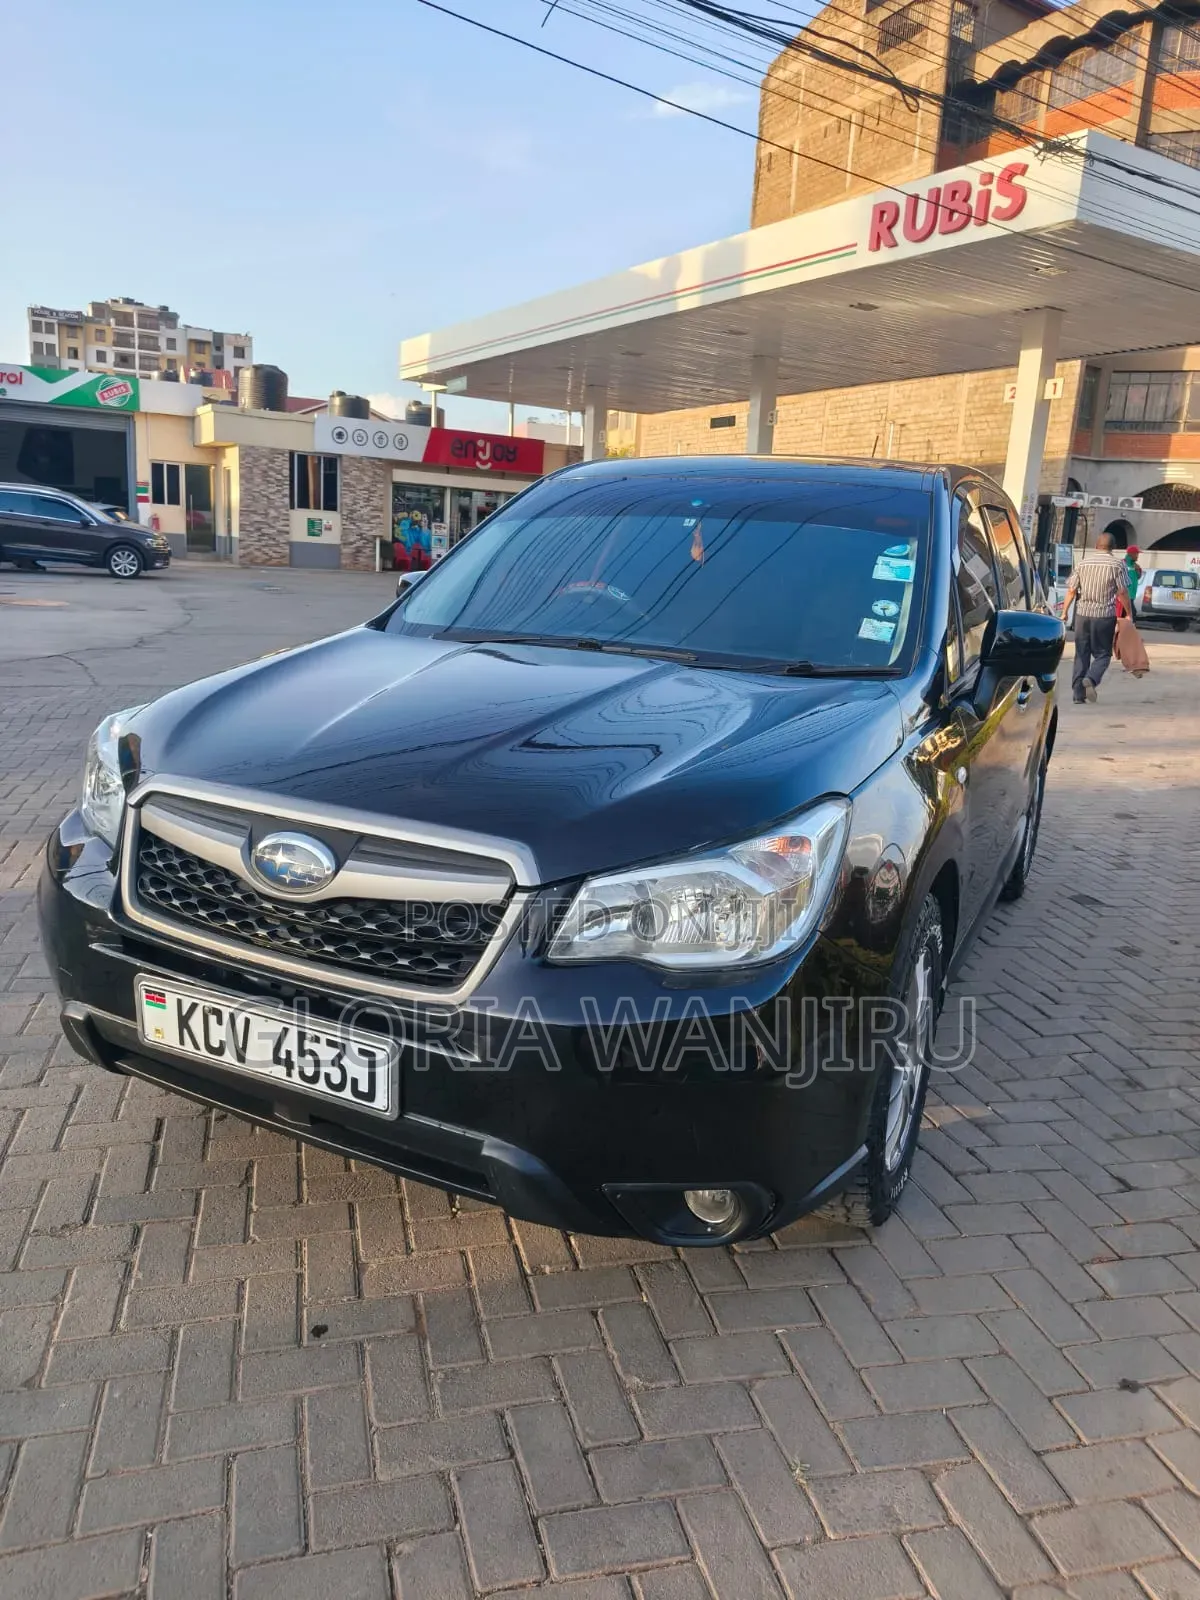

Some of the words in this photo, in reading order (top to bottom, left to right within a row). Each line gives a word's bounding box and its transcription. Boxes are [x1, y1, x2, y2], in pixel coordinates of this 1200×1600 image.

[1009, 386, 1017, 400] 2
[176, 997, 251, 1065] KCV
[271, 1026, 378, 1104] 453J
